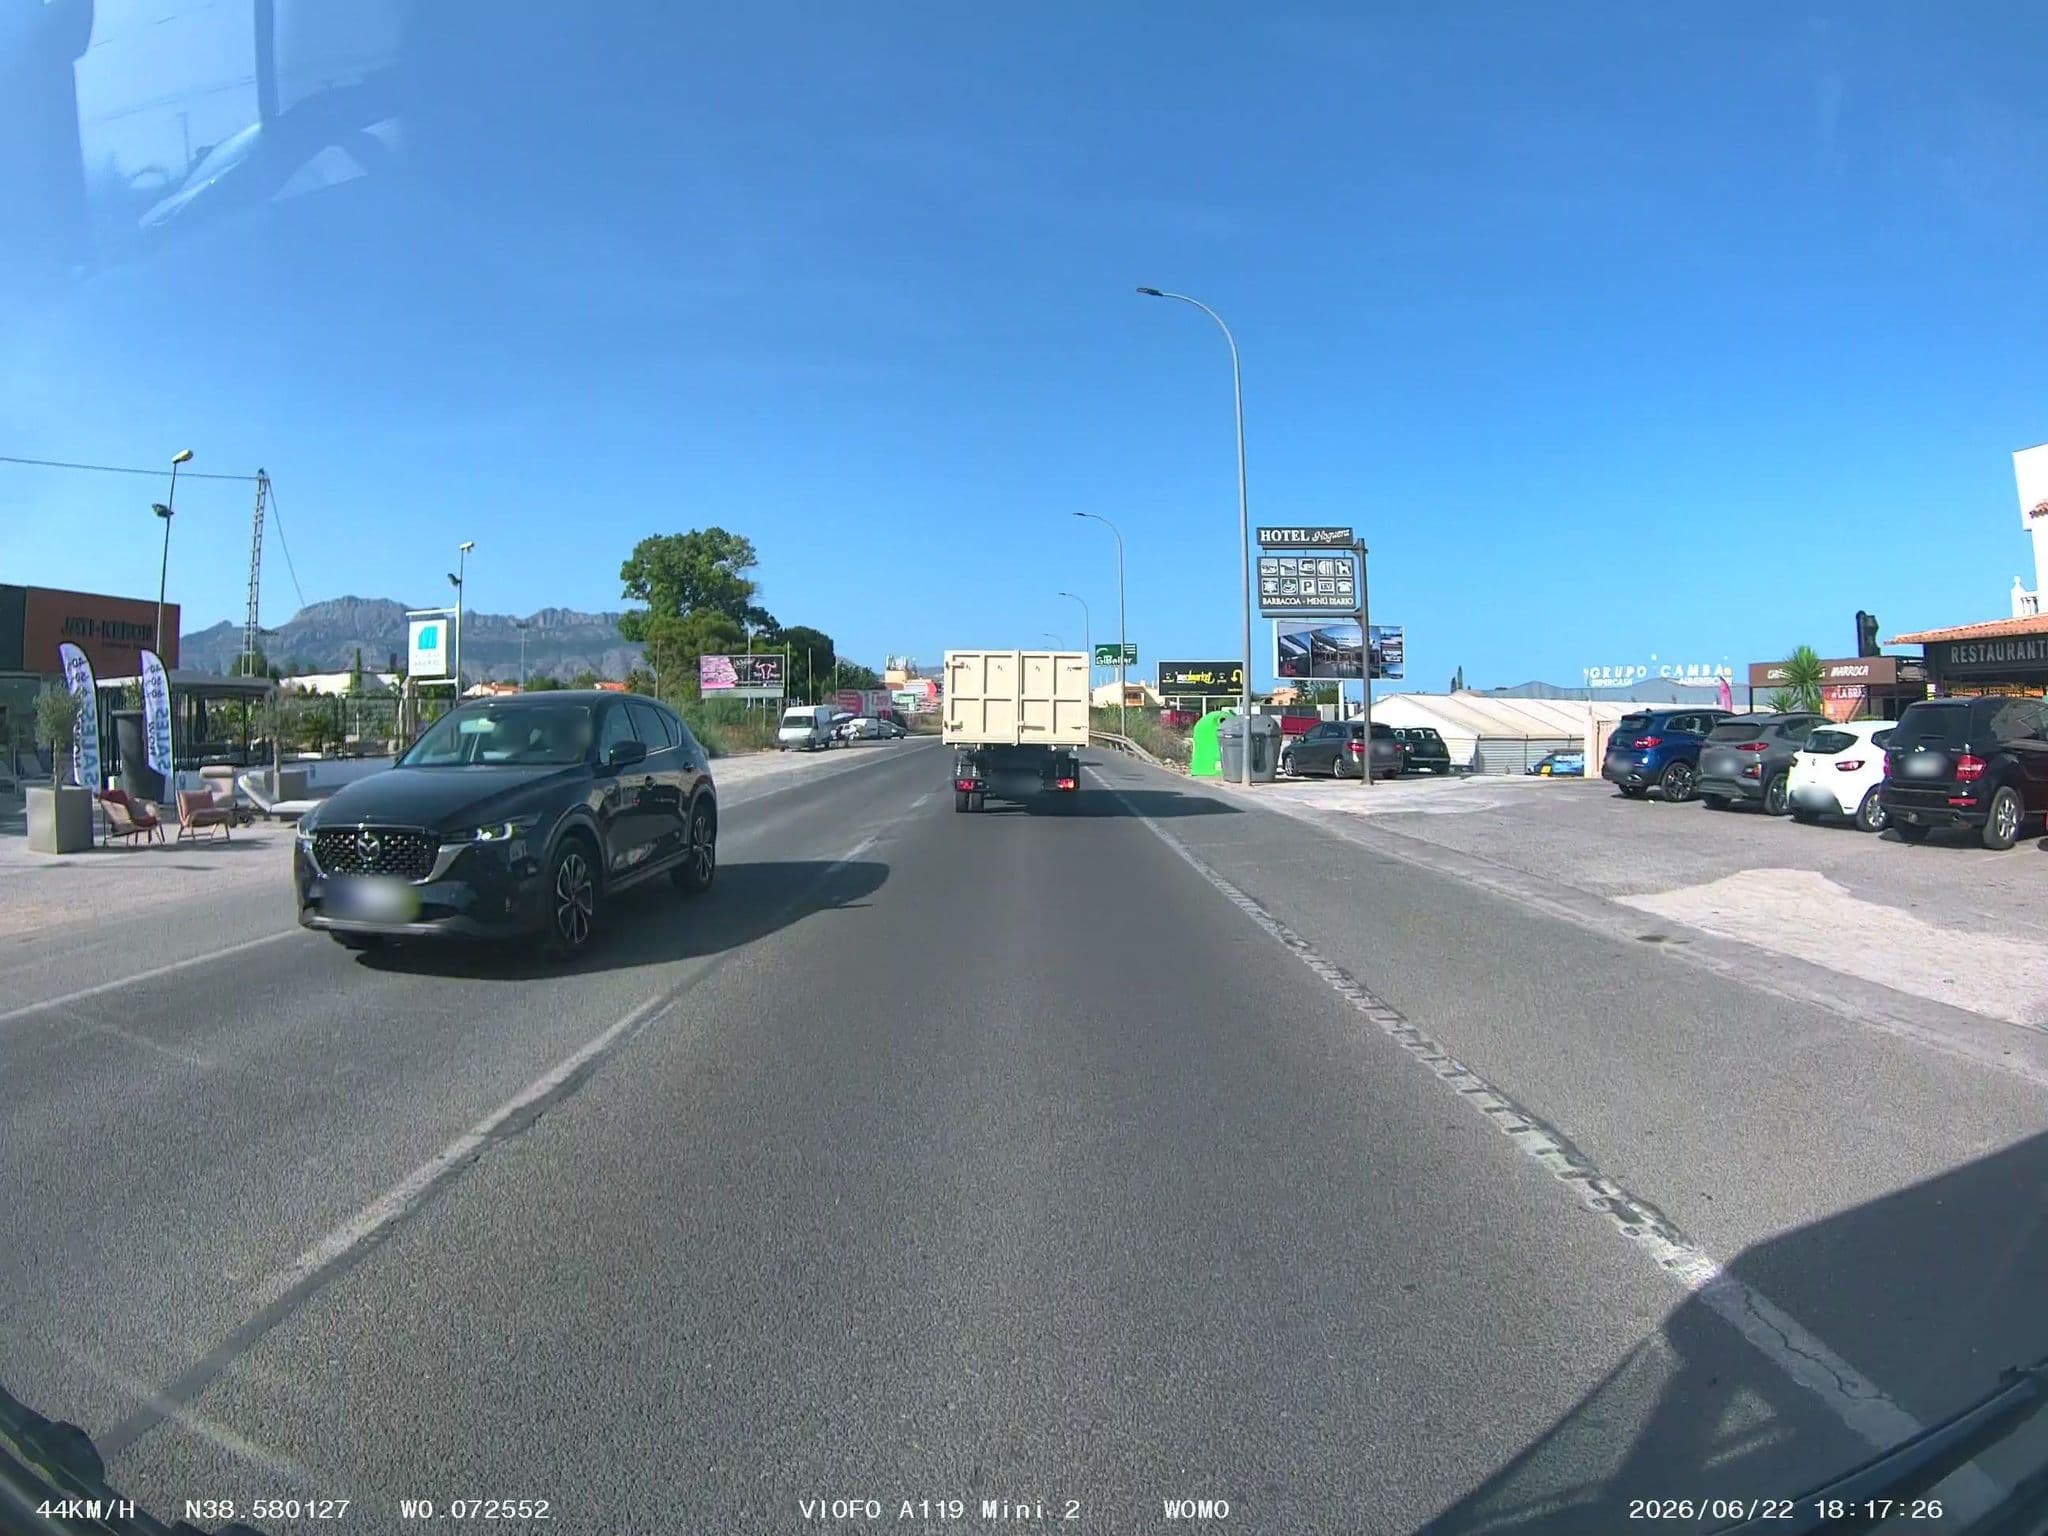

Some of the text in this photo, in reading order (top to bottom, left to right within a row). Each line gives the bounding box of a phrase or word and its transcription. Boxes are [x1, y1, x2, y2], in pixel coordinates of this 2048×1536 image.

[1260, 529, 1310, 542] HOTEL
[1262, 597, 1301, 606] BARBACOA
[1329, 597, 1354, 605] DIARIO
[1589, 665, 1647, 680] GRUPO
